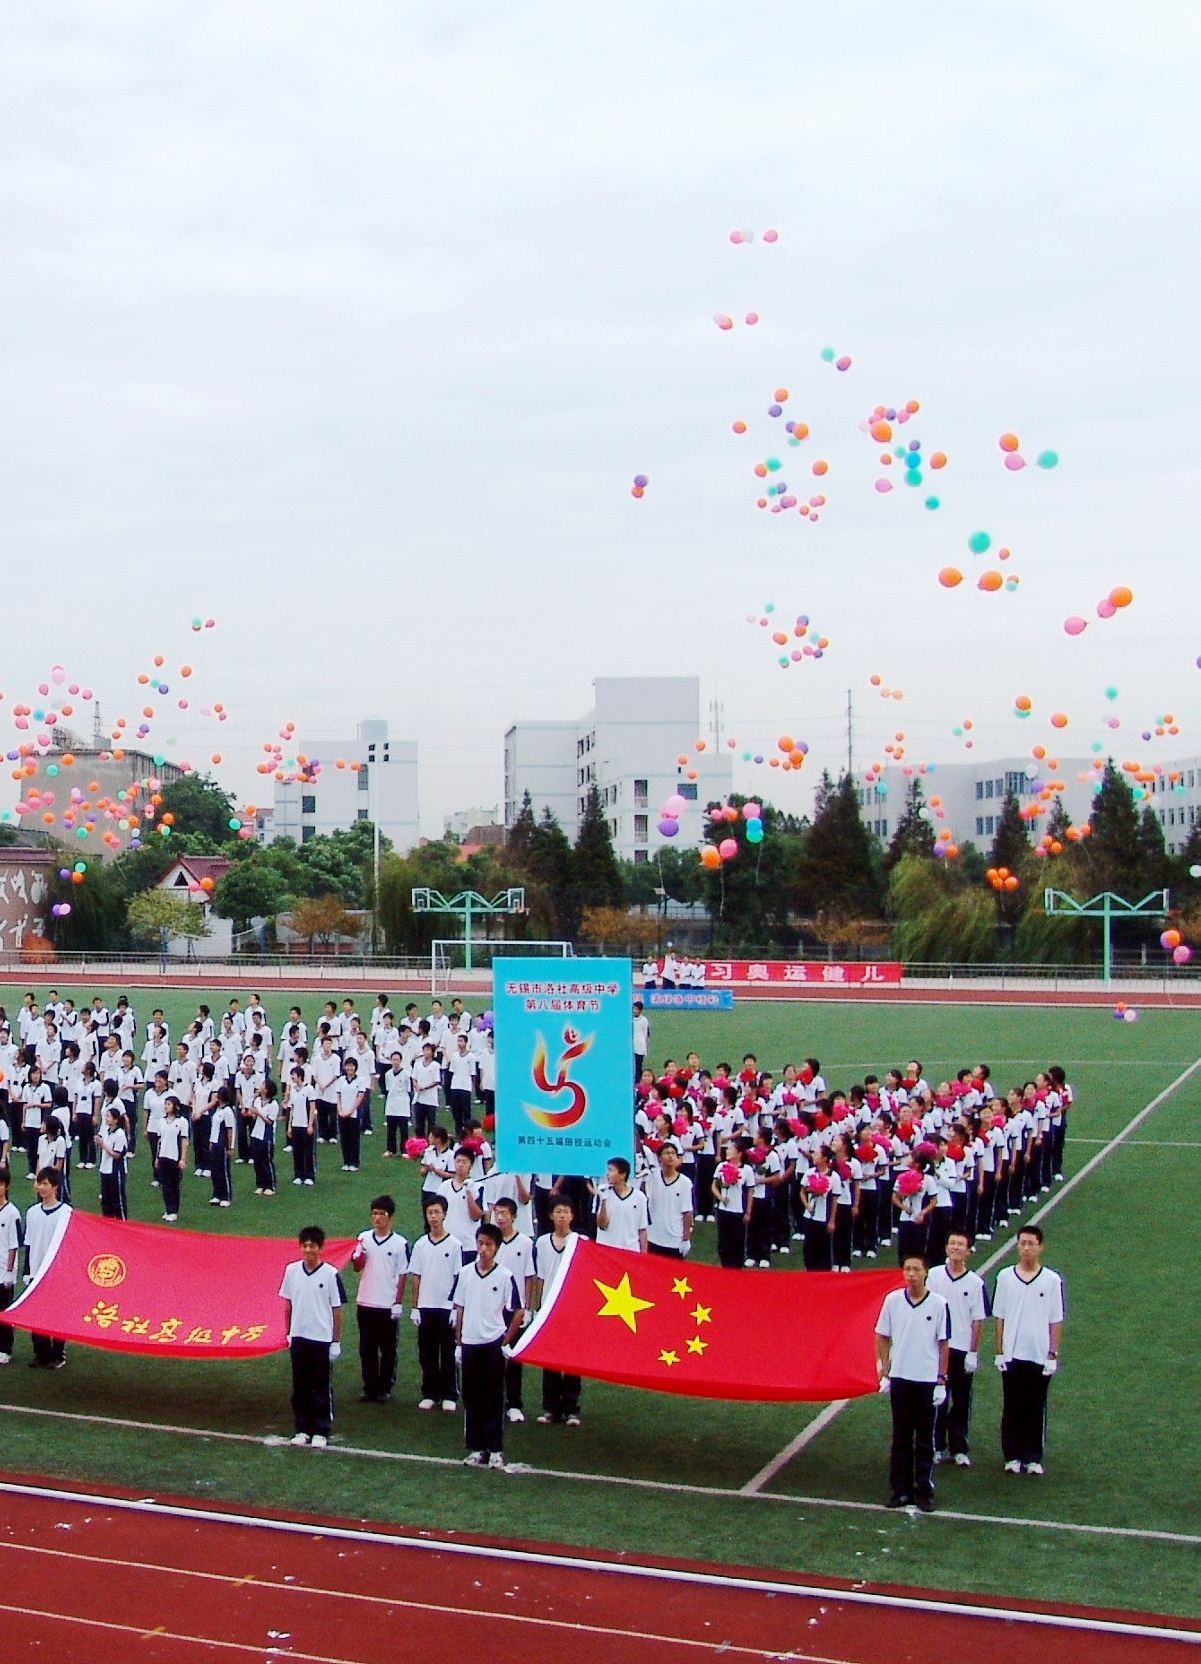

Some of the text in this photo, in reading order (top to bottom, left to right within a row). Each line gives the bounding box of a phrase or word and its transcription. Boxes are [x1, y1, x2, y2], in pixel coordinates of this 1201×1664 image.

[677, 962, 885, 982] 习奥运健儿
[506, 982, 618, 995] 无锡市洛社高级中学
[525, 998, 600, 1011] 第八届体育节
[517, 1135, 611, 1148] 第四十五届田径运动会
[83, 1300, 268, 1345] 洛社高级中学
